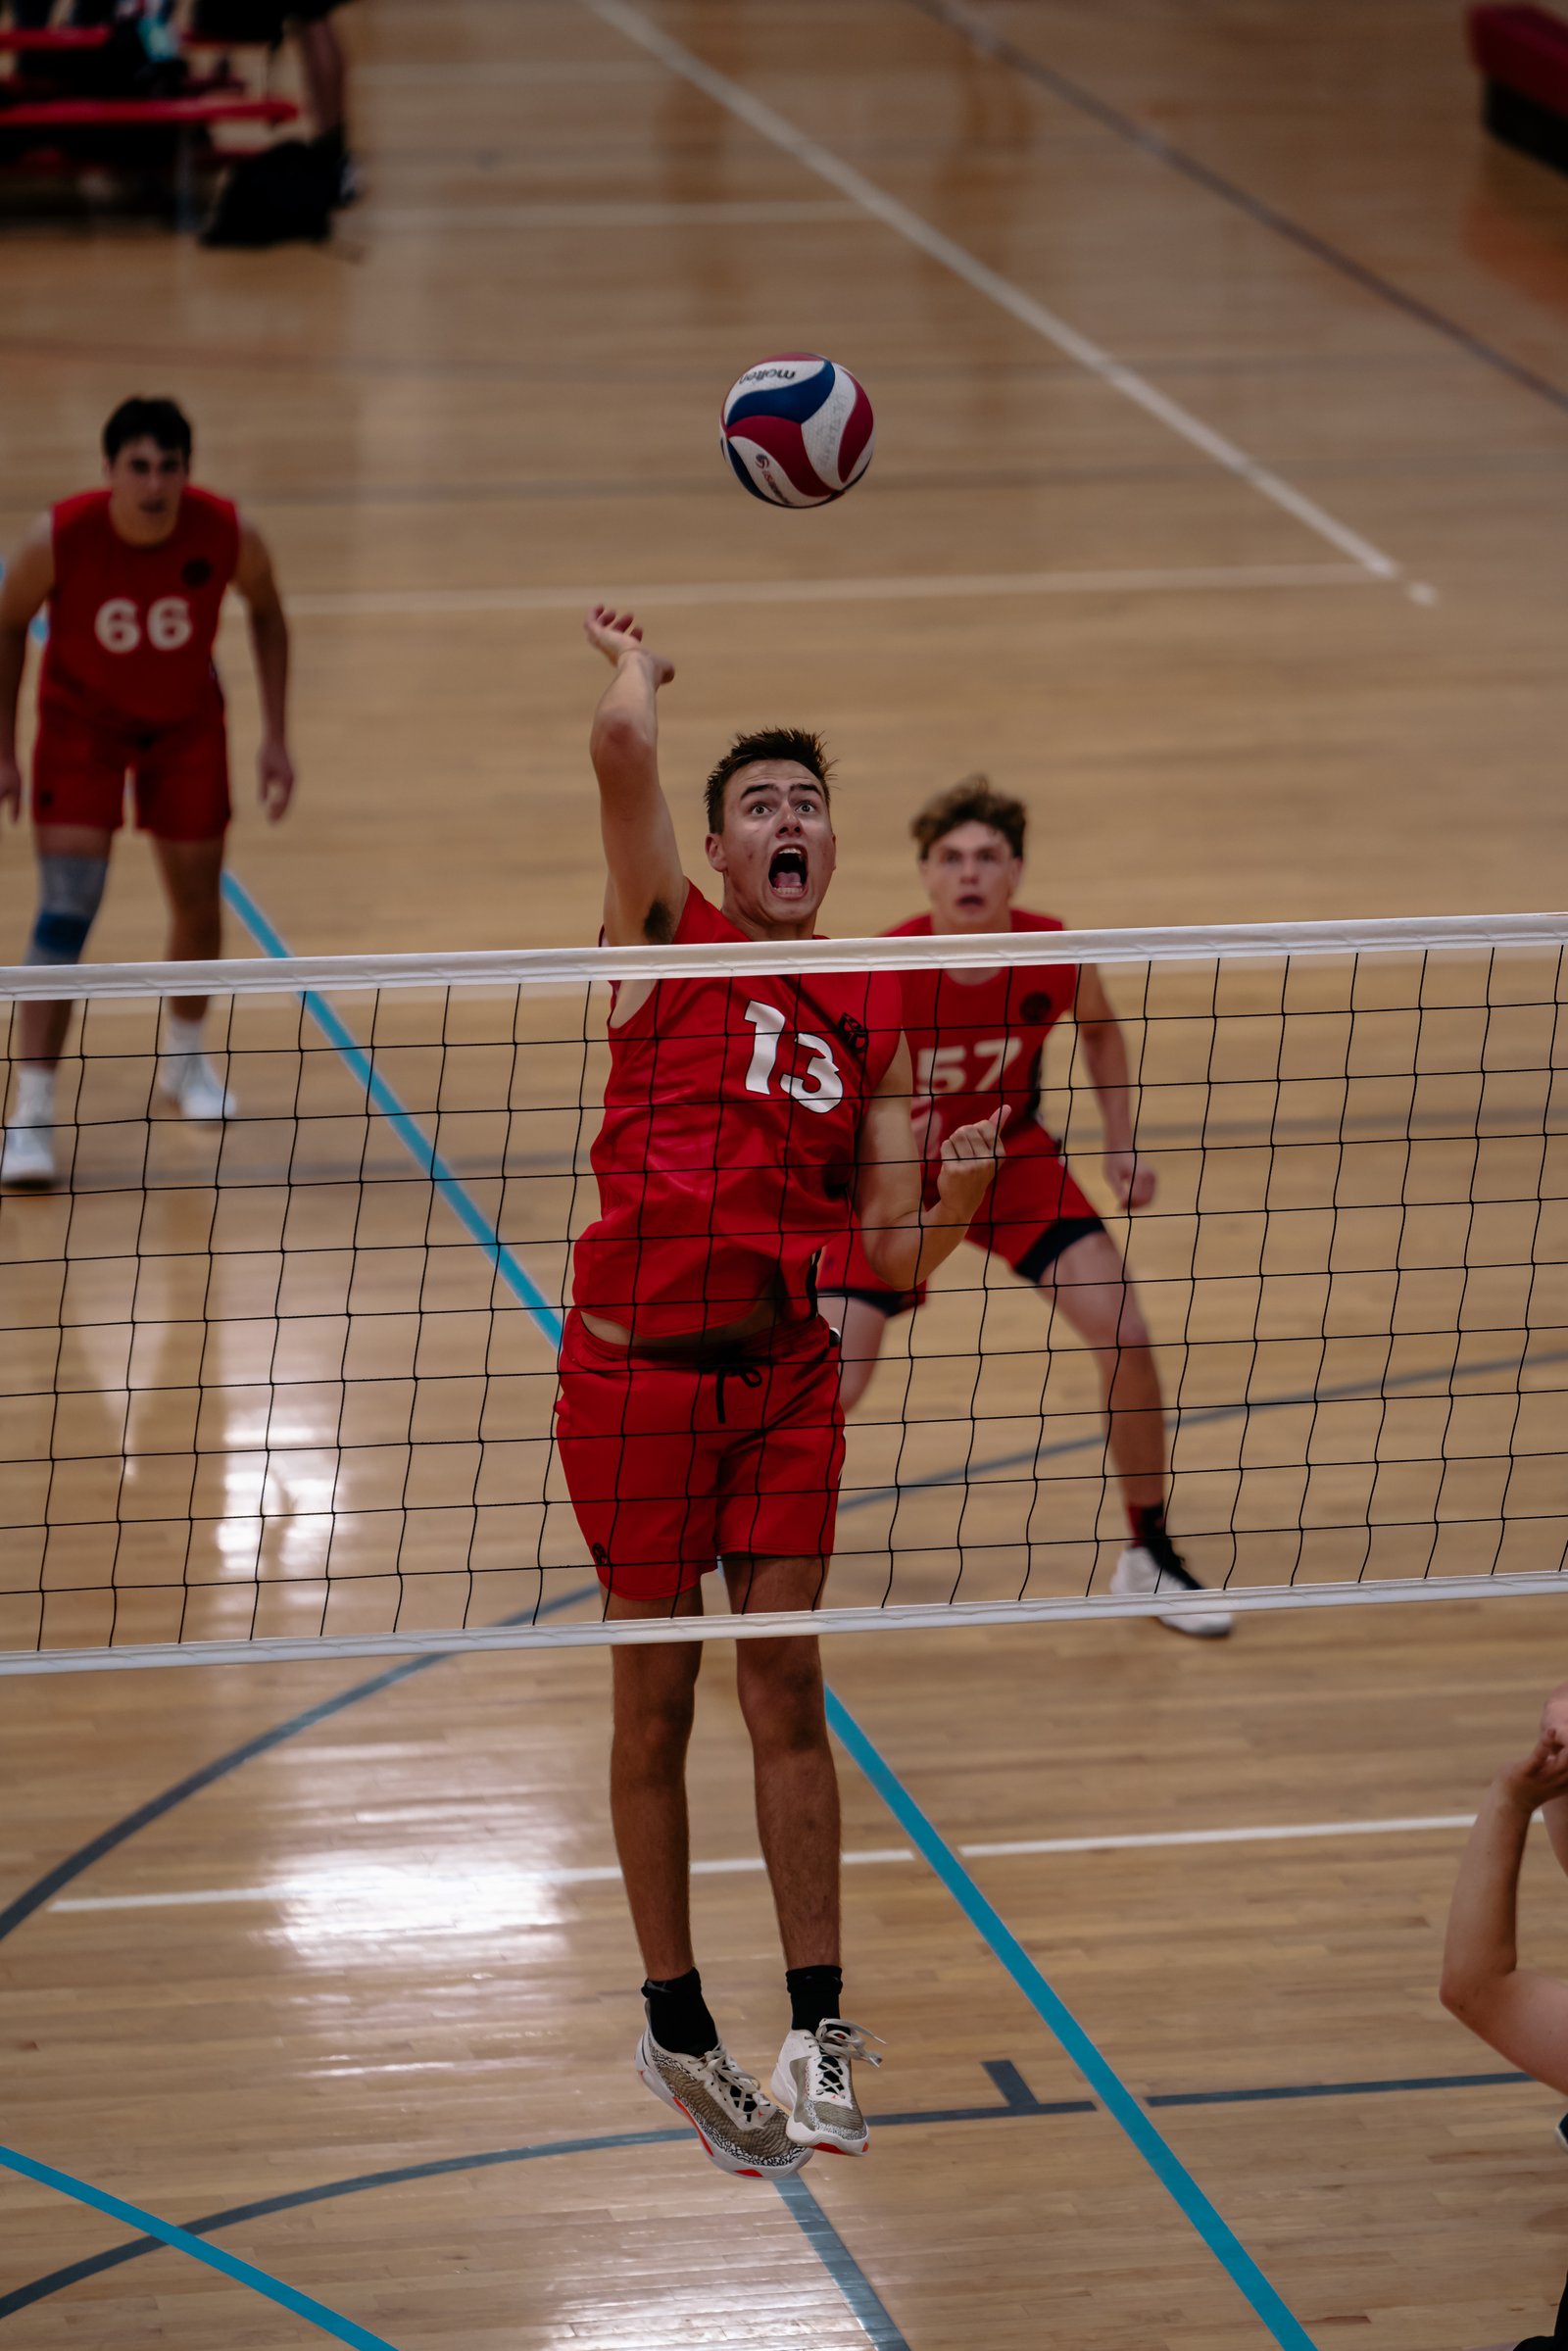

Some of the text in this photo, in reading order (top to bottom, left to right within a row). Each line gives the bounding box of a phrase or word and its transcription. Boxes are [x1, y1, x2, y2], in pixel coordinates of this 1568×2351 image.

[739, 368, 796, 384] molten
[94, 596, 193, 654] 66
[744, 999, 844, 1113] 13
[916, 1036, 1022, 1099] 57
